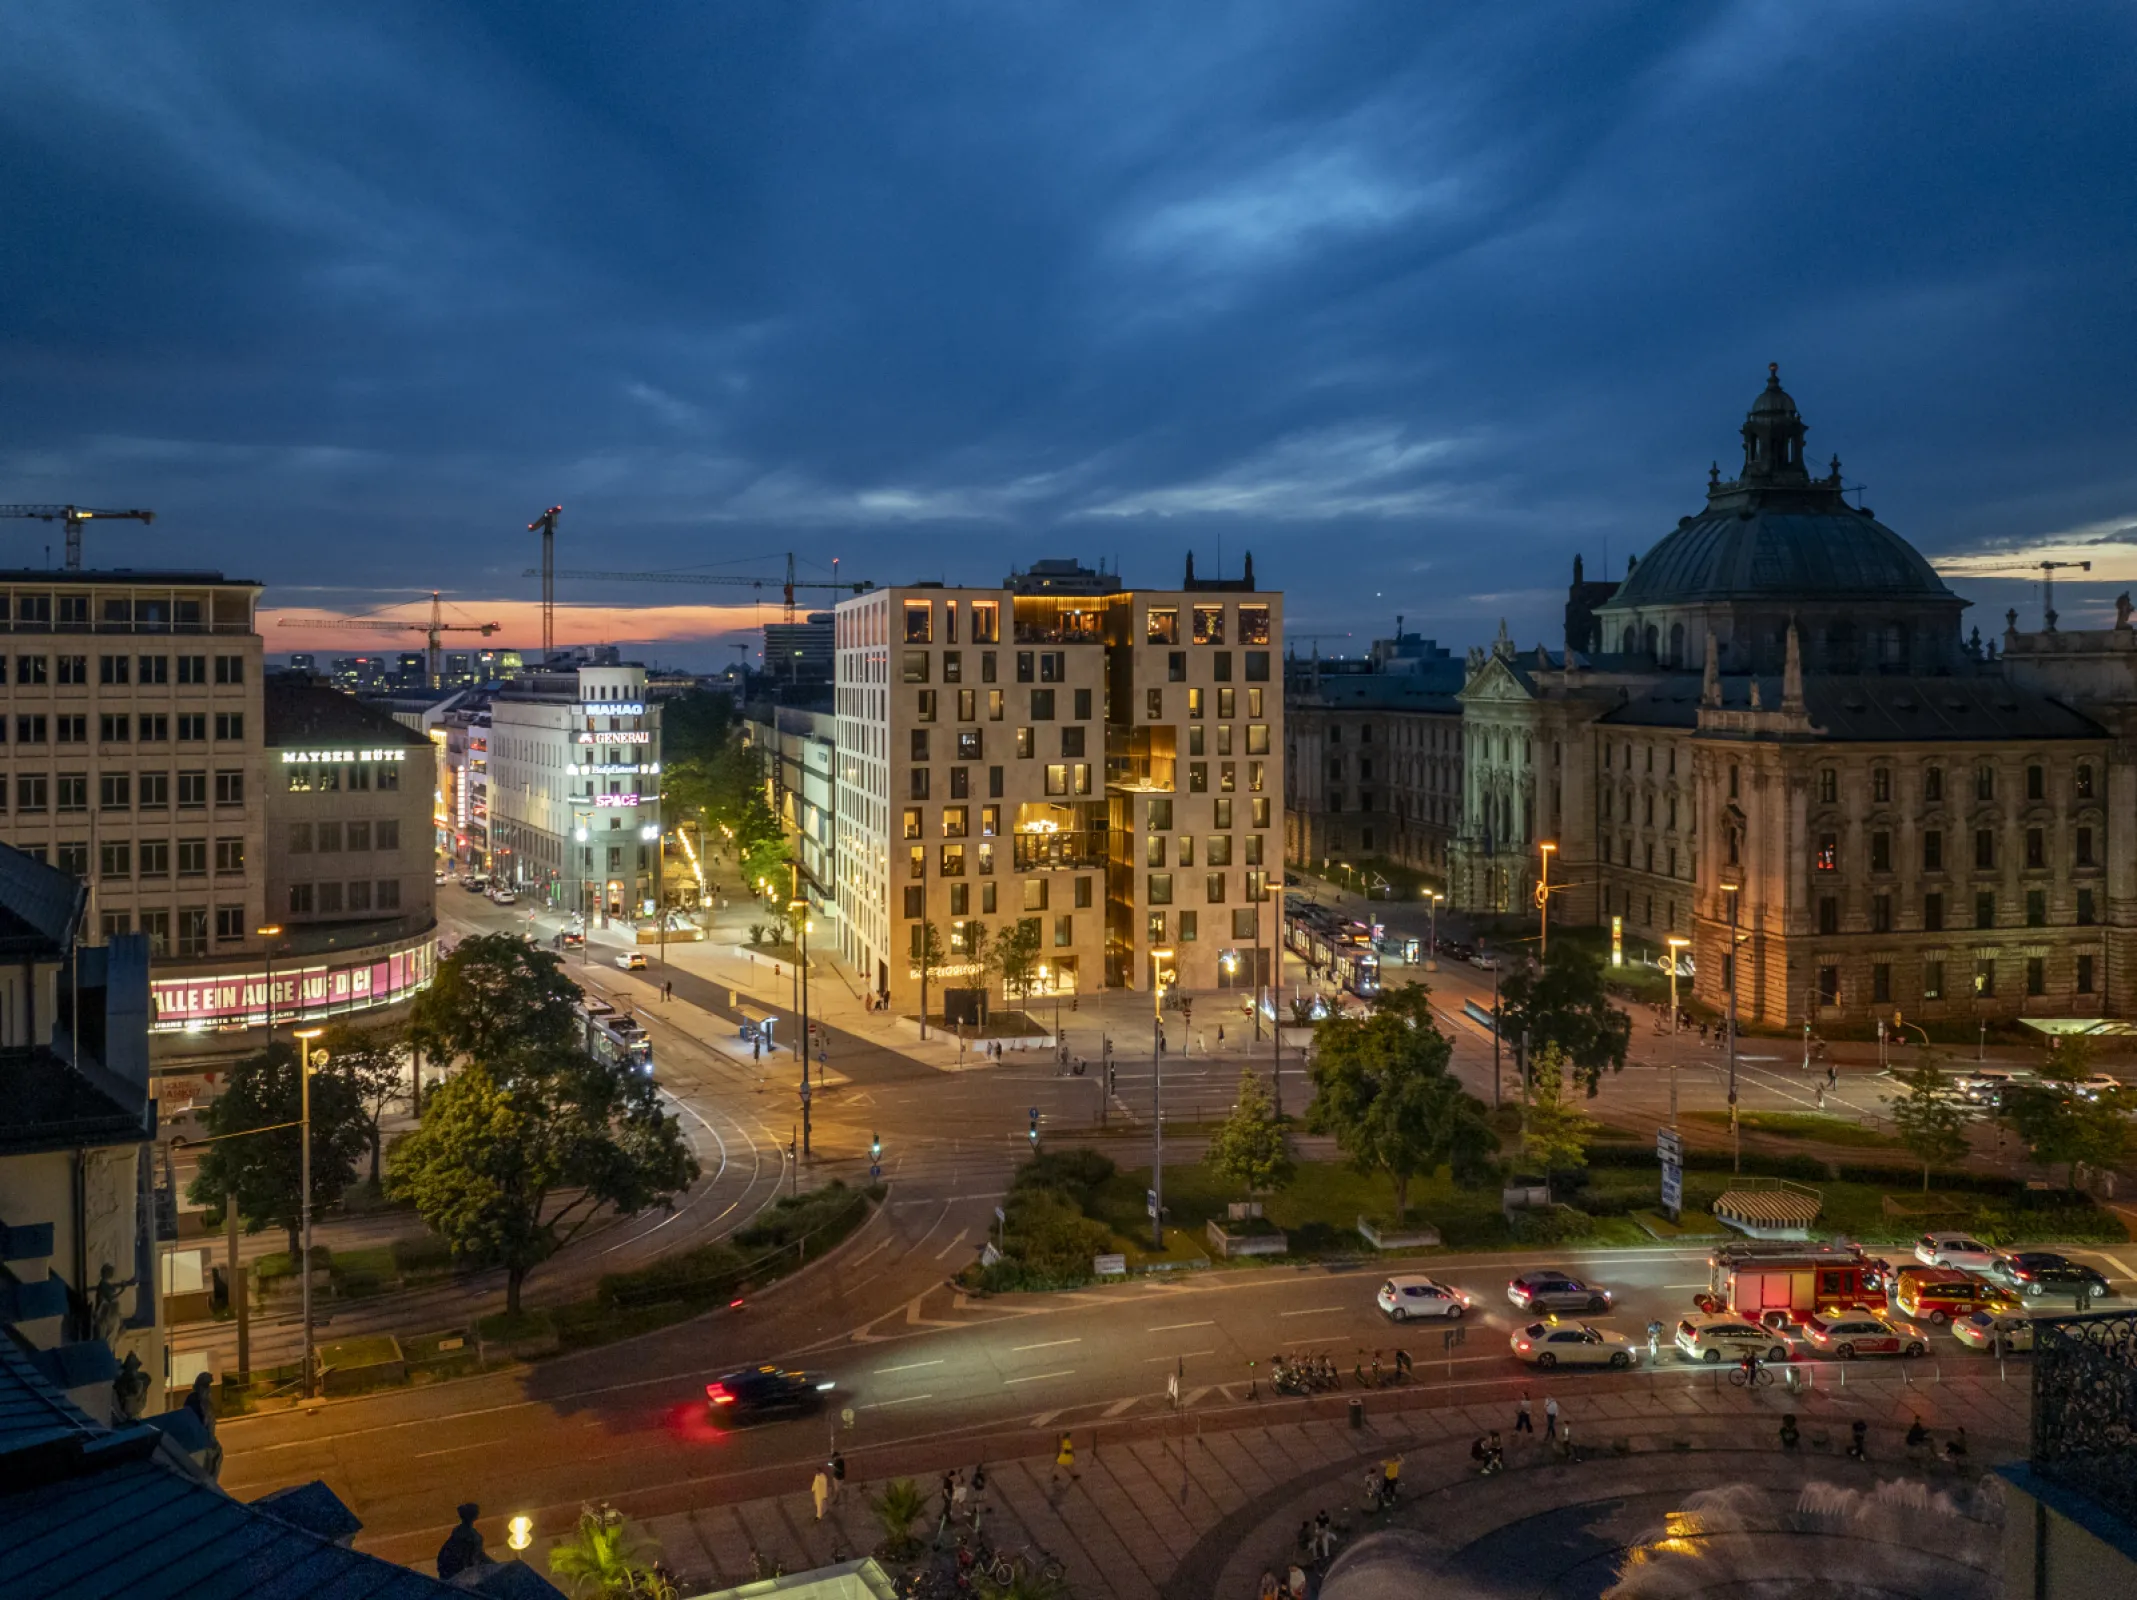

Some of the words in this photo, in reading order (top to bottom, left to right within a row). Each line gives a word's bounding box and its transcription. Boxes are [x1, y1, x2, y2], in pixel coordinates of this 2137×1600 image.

[596, 731, 649, 743] GENERALI
[282, 750, 354, 763] MAYSER
[360, 748, 405, 761] HÜTE
[596, 794, 638, 807] SPACE
[203, 986, 236, 1010] EIN
[242, 981, 294, 1006] AUGE
